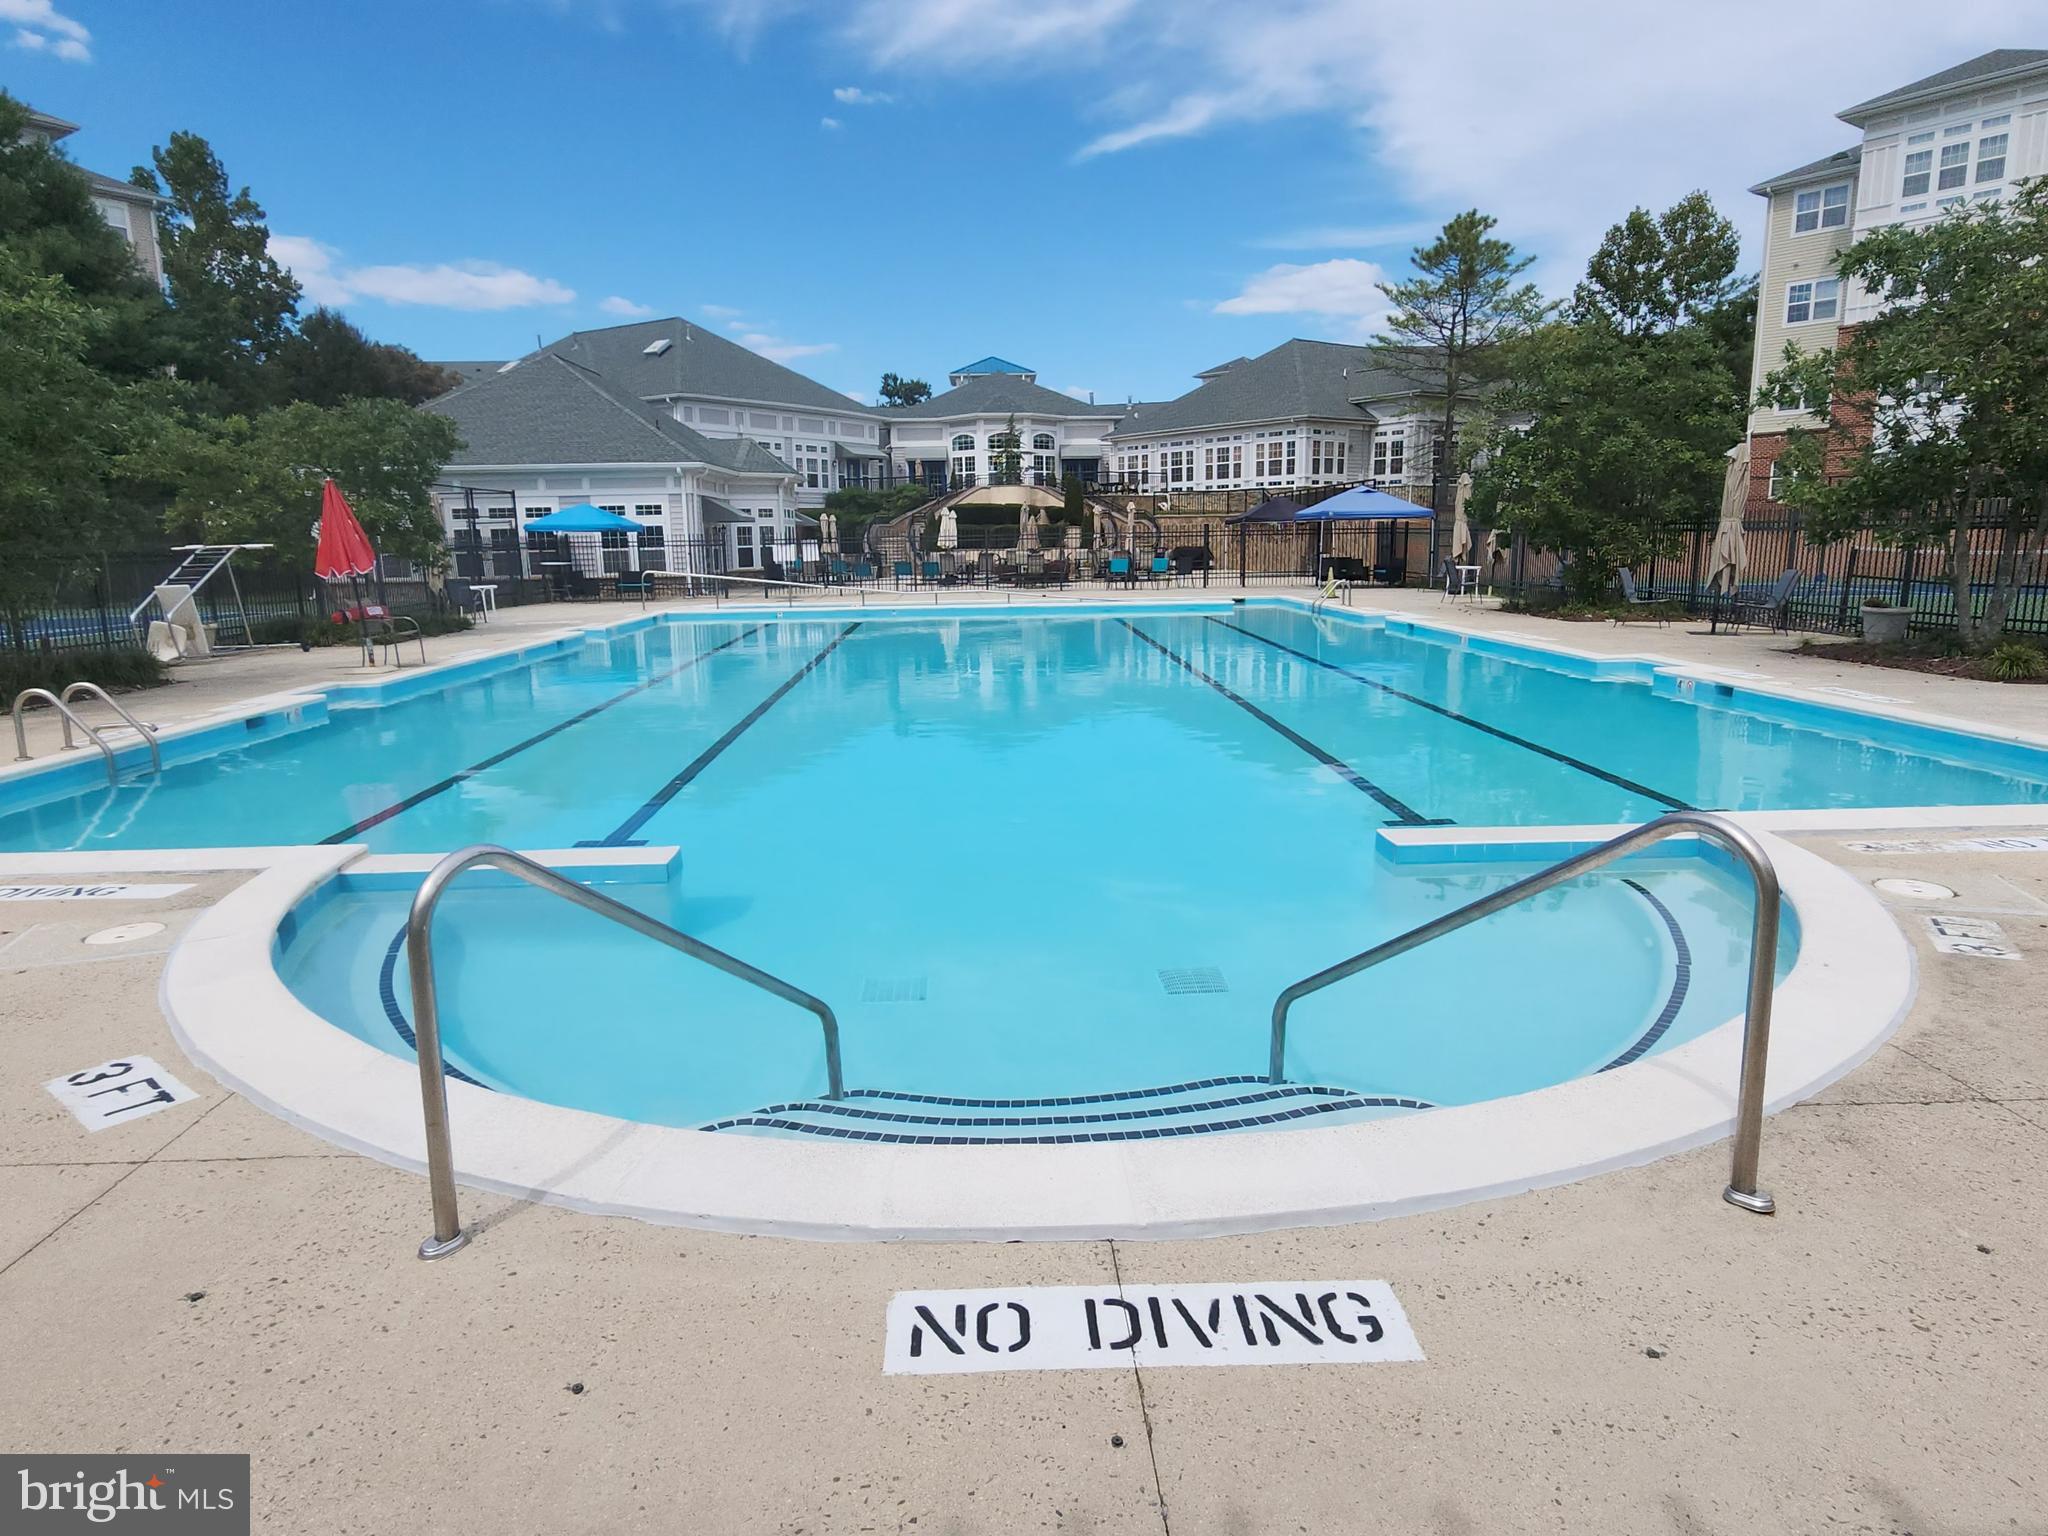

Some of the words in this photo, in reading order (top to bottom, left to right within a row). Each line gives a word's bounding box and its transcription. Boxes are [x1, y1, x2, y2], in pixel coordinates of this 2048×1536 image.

[1930, 917, 1994, 941] FT
[1951, 943, 2008, 956] 3
[67, 1062, 134, 1087] 3
[87, 1077, 176, 1117] FT
[909, 1301, 1031, 1358] NO
[1084, 1291, 1384, 1350] DIVING
